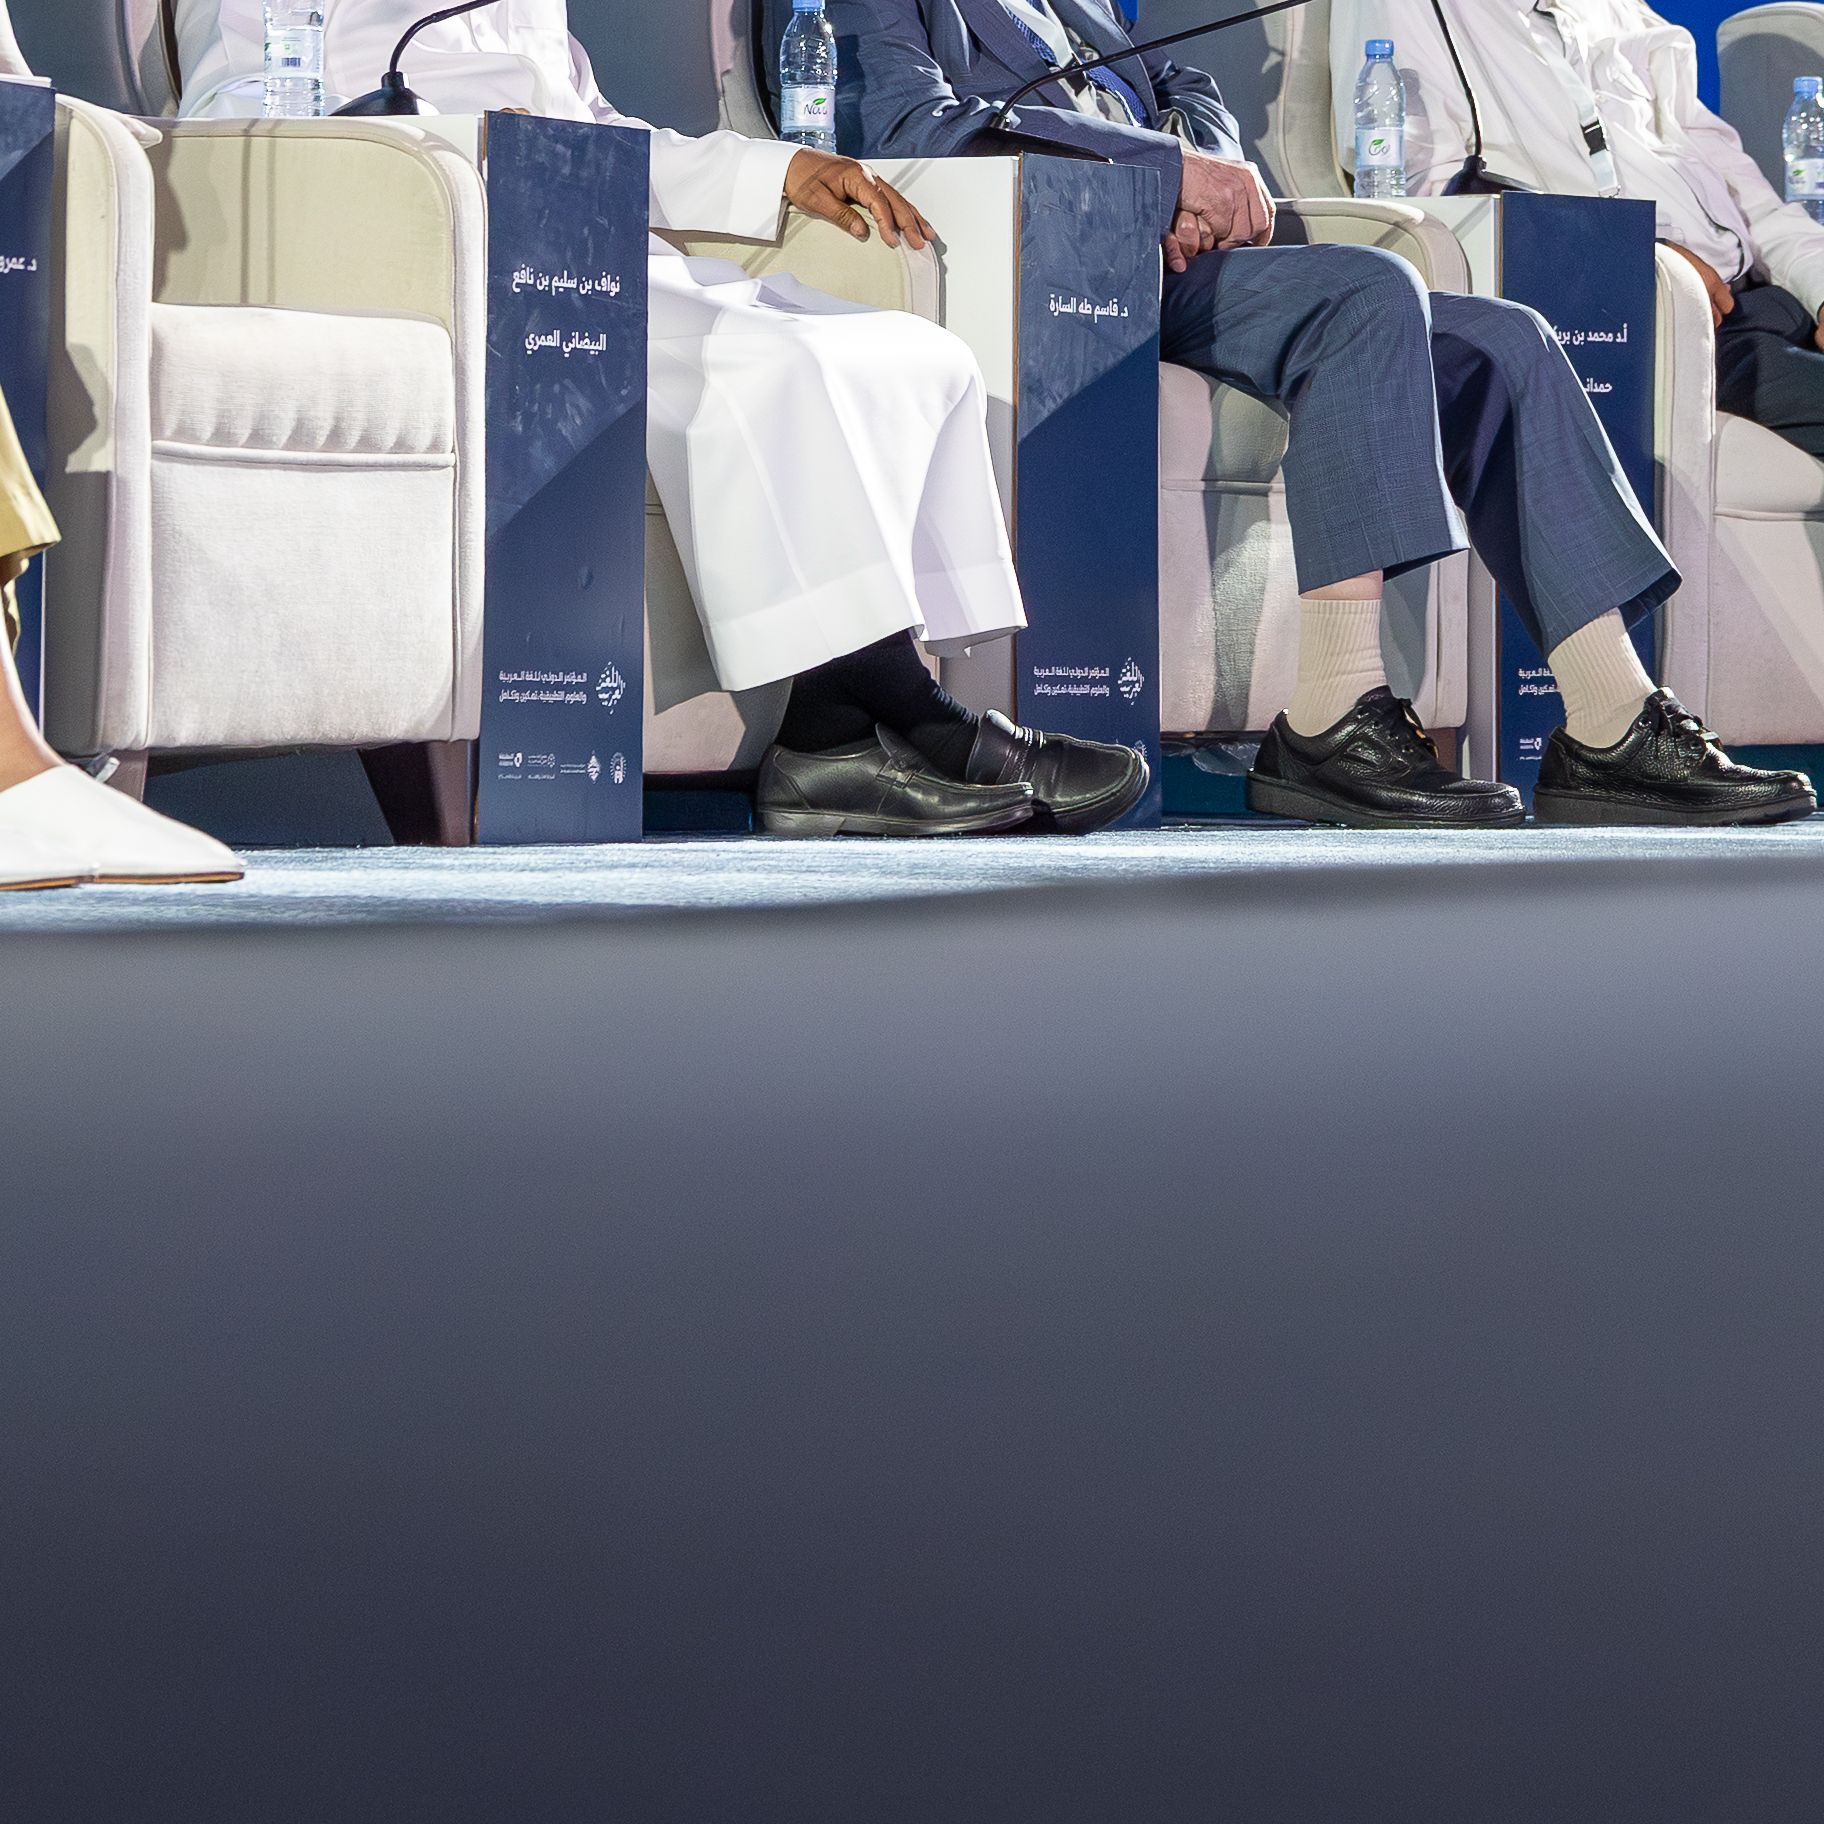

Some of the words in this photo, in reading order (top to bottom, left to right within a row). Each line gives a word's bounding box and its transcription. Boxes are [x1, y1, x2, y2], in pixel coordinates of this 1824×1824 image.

[512, 264, 534, 293] نافع
[536, 272, 549, 291] بن
[551, 270, 577, 296] سليم
[579, 276, 592, 294] بن
[595, 271, 621, 296] نواف
[1049, 293, 1076, 316] السارة
[1078, 298, 1092, 315] طه
[1094, 298, 1119, 324] قاسم
[525, 330, 560, 355] العمري
[1572, 329, 1585, 345] بن
[1587, 330, 1613, 342] محمد
